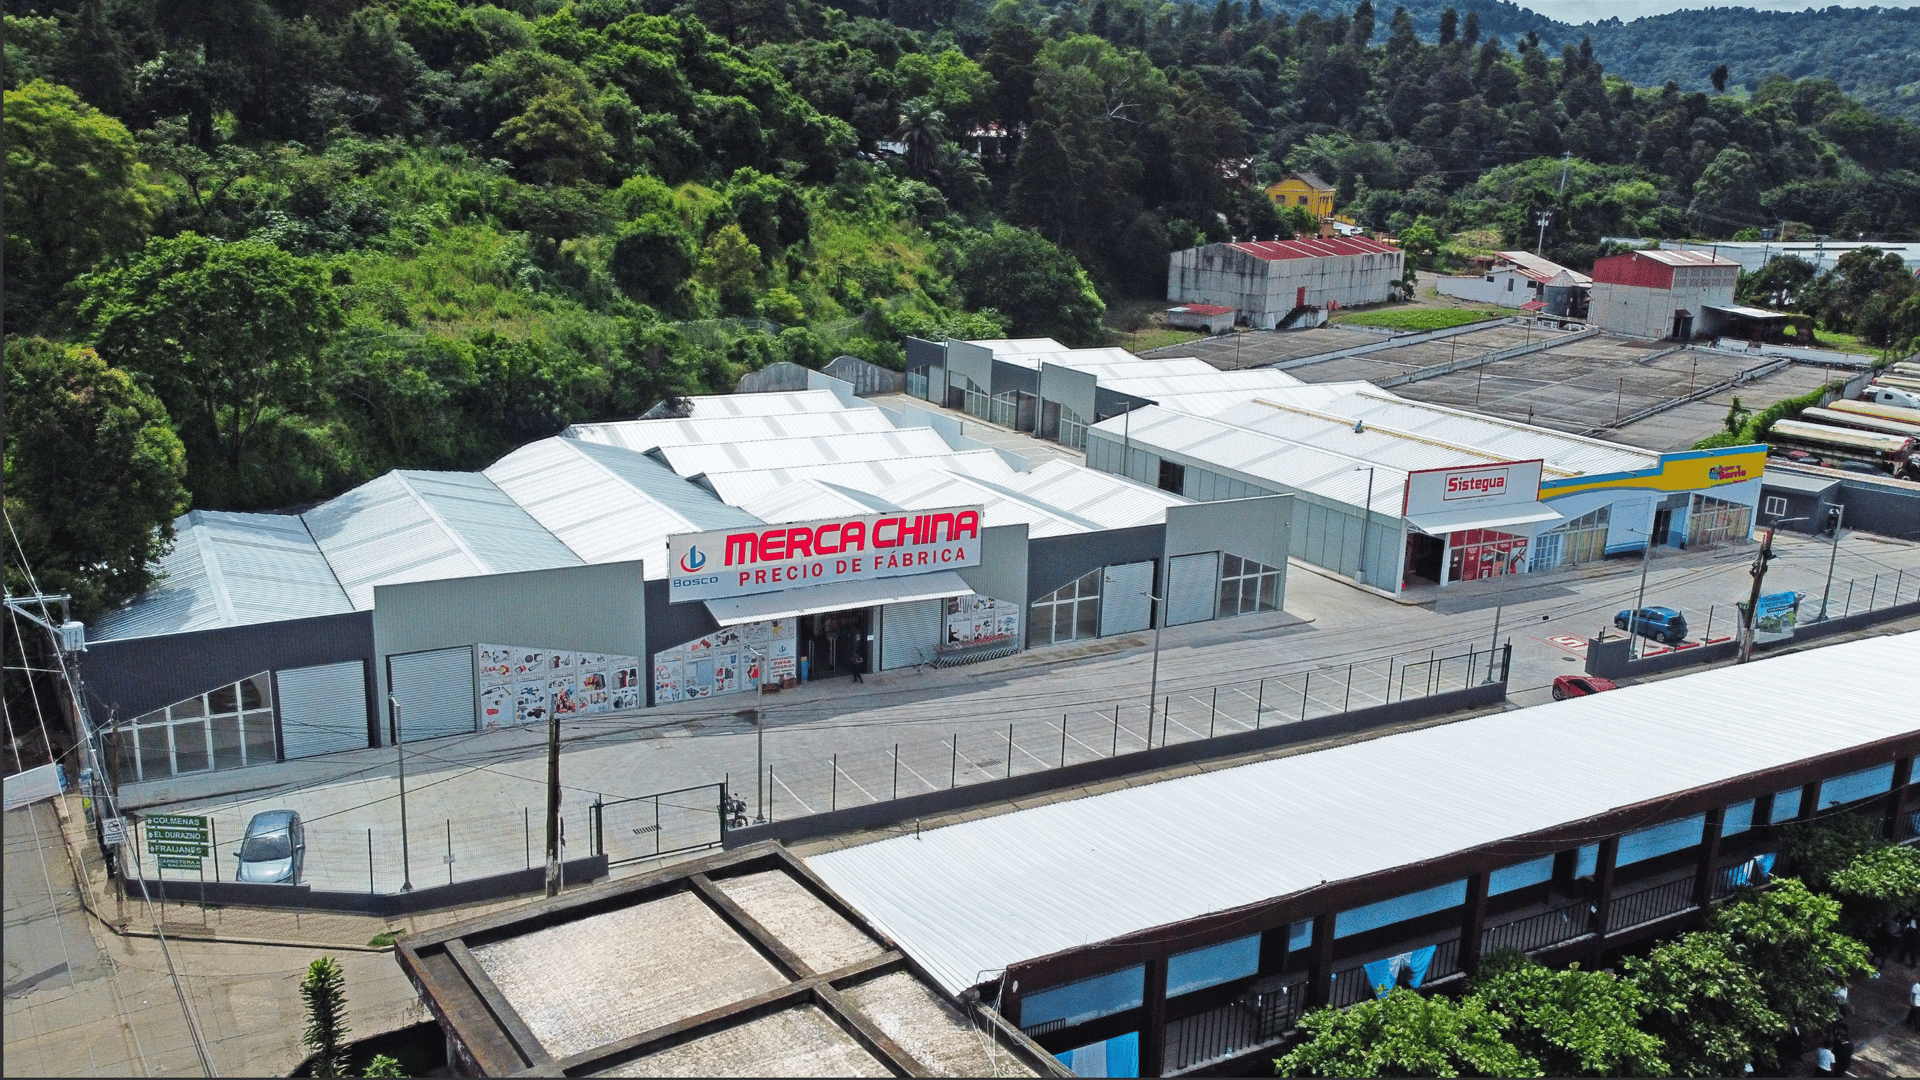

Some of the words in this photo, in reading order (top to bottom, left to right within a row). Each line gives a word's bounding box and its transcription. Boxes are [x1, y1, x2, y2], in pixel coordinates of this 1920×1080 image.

[1447, 476, 1505, 492] Sistegua
[724, 521, 866, 566] MERCA
[872, 510, 979, 549] CHINA
[739, 562, 824, 587] PRECIO
[836, 558, 862, 575] DE
[874, 547, 966, 570] FÁBRICA
[152, 817, 200, 826] COLMENAS
[165, 831, 201, 840] DURAZNO
[155, 844, 202, 854] FRAIJANES
